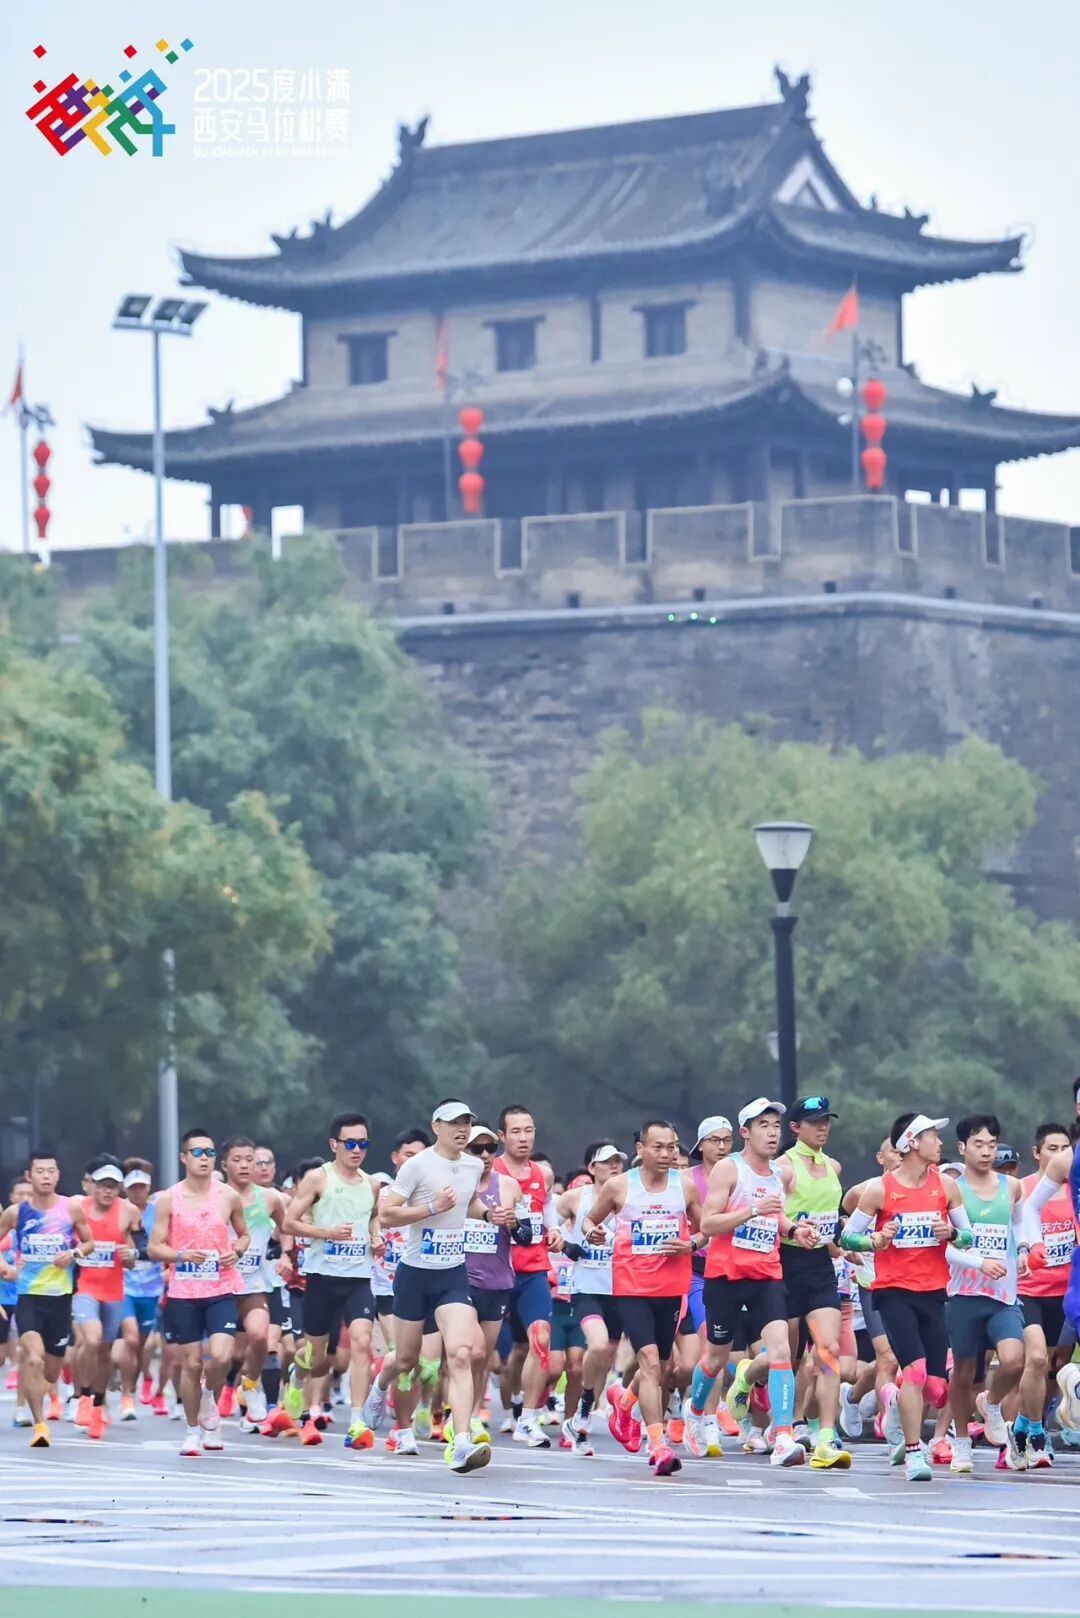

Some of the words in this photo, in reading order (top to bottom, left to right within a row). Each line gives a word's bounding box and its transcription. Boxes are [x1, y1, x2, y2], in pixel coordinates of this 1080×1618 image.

[632, 1222, 641, 1233] A
[902, 1225, 935, 1239] 2217
[423, 1232, 432, 1242] A
[466, 1232, 495, 1244] 6809
[745, 1227, 775, 1243] 14325
[334, 1244, 364, 1255] 12765
[432, 1242, 463, 1254] 16560
[184, 1261, 217, 1272] 11398
